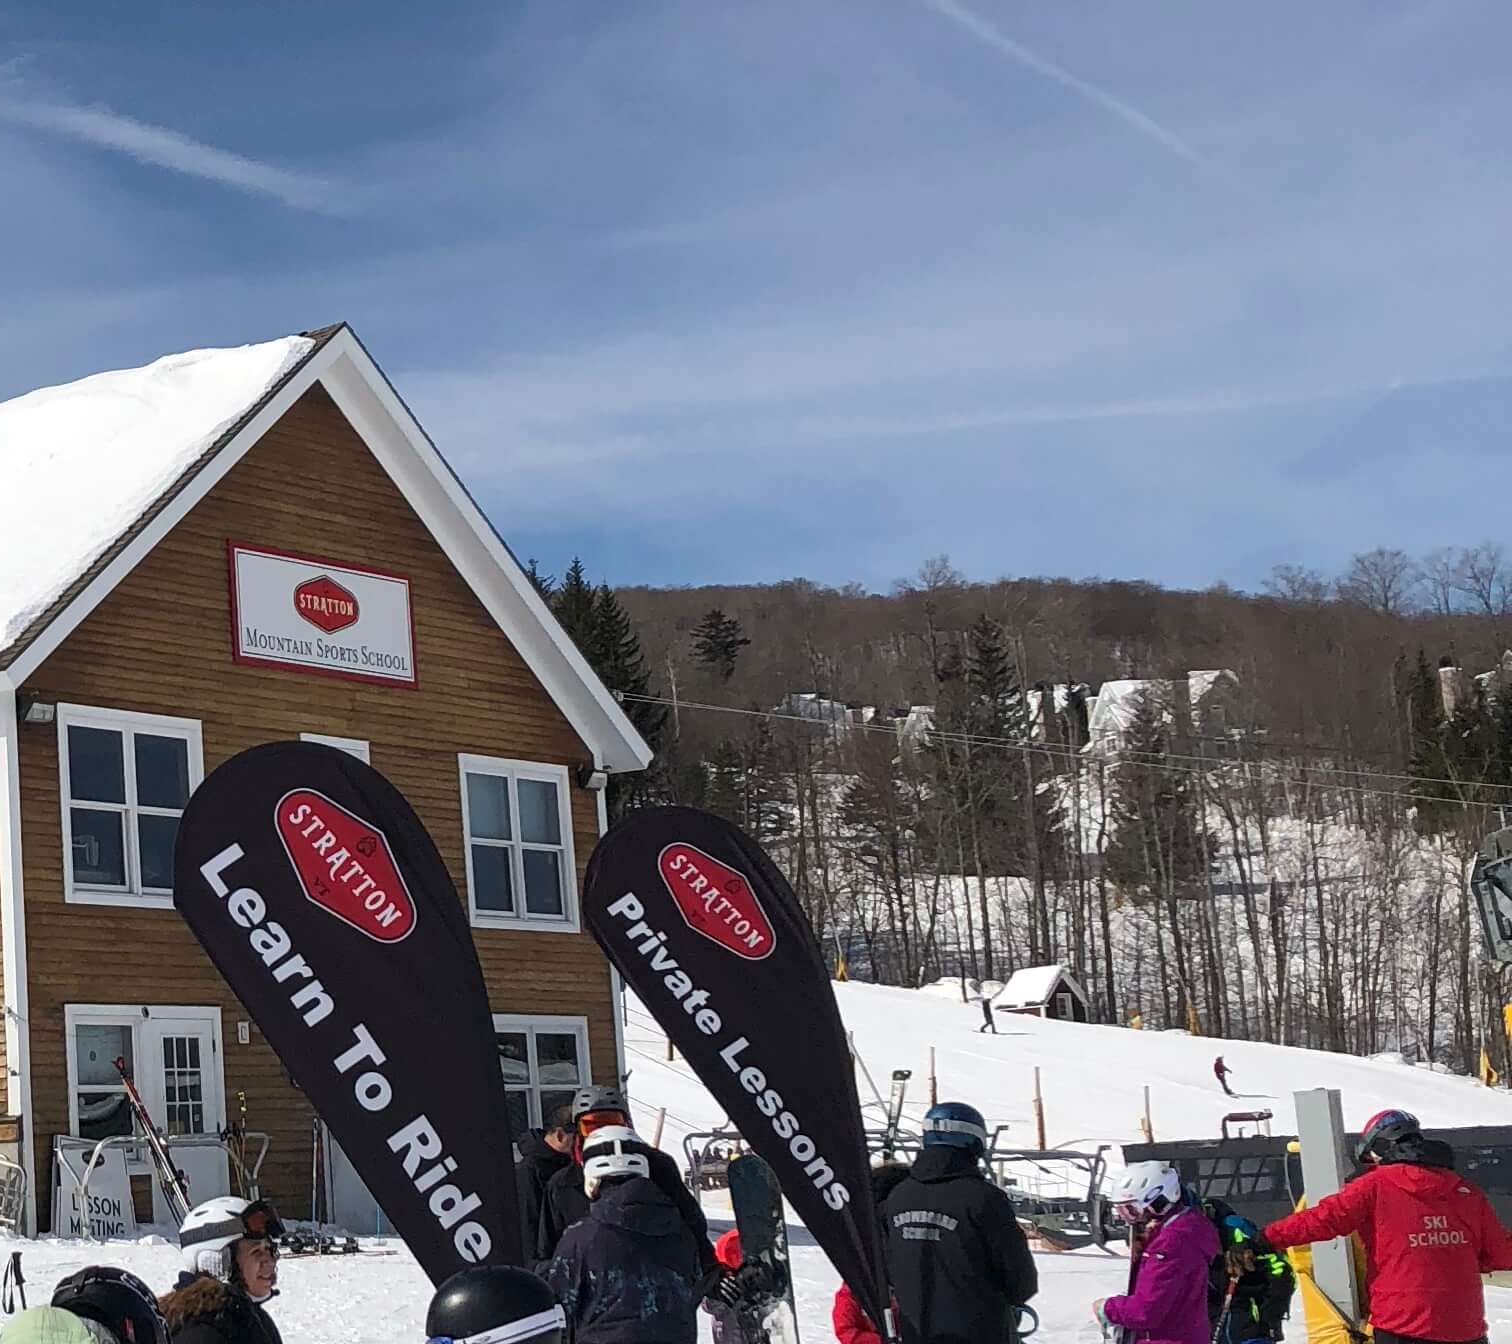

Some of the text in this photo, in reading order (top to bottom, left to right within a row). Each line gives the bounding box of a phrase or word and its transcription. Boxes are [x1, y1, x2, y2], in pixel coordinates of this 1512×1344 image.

[299, 593, 354, 617] STRATTON
[288, 804, 403, 928] STRATTON
[669, 854, 765, 948] STRATTON
[199, 842, 492, 1264] Learn To Ride
[606, 891, 851, 1212] Private Lessons
[71, 1192, 121, 1217] LSSON
[69, 1215, 125, 1236] MTING
[1423, 1215, 1448, 1230] SKI
[1408, 1231, 1469, 1248] SCHOOL
